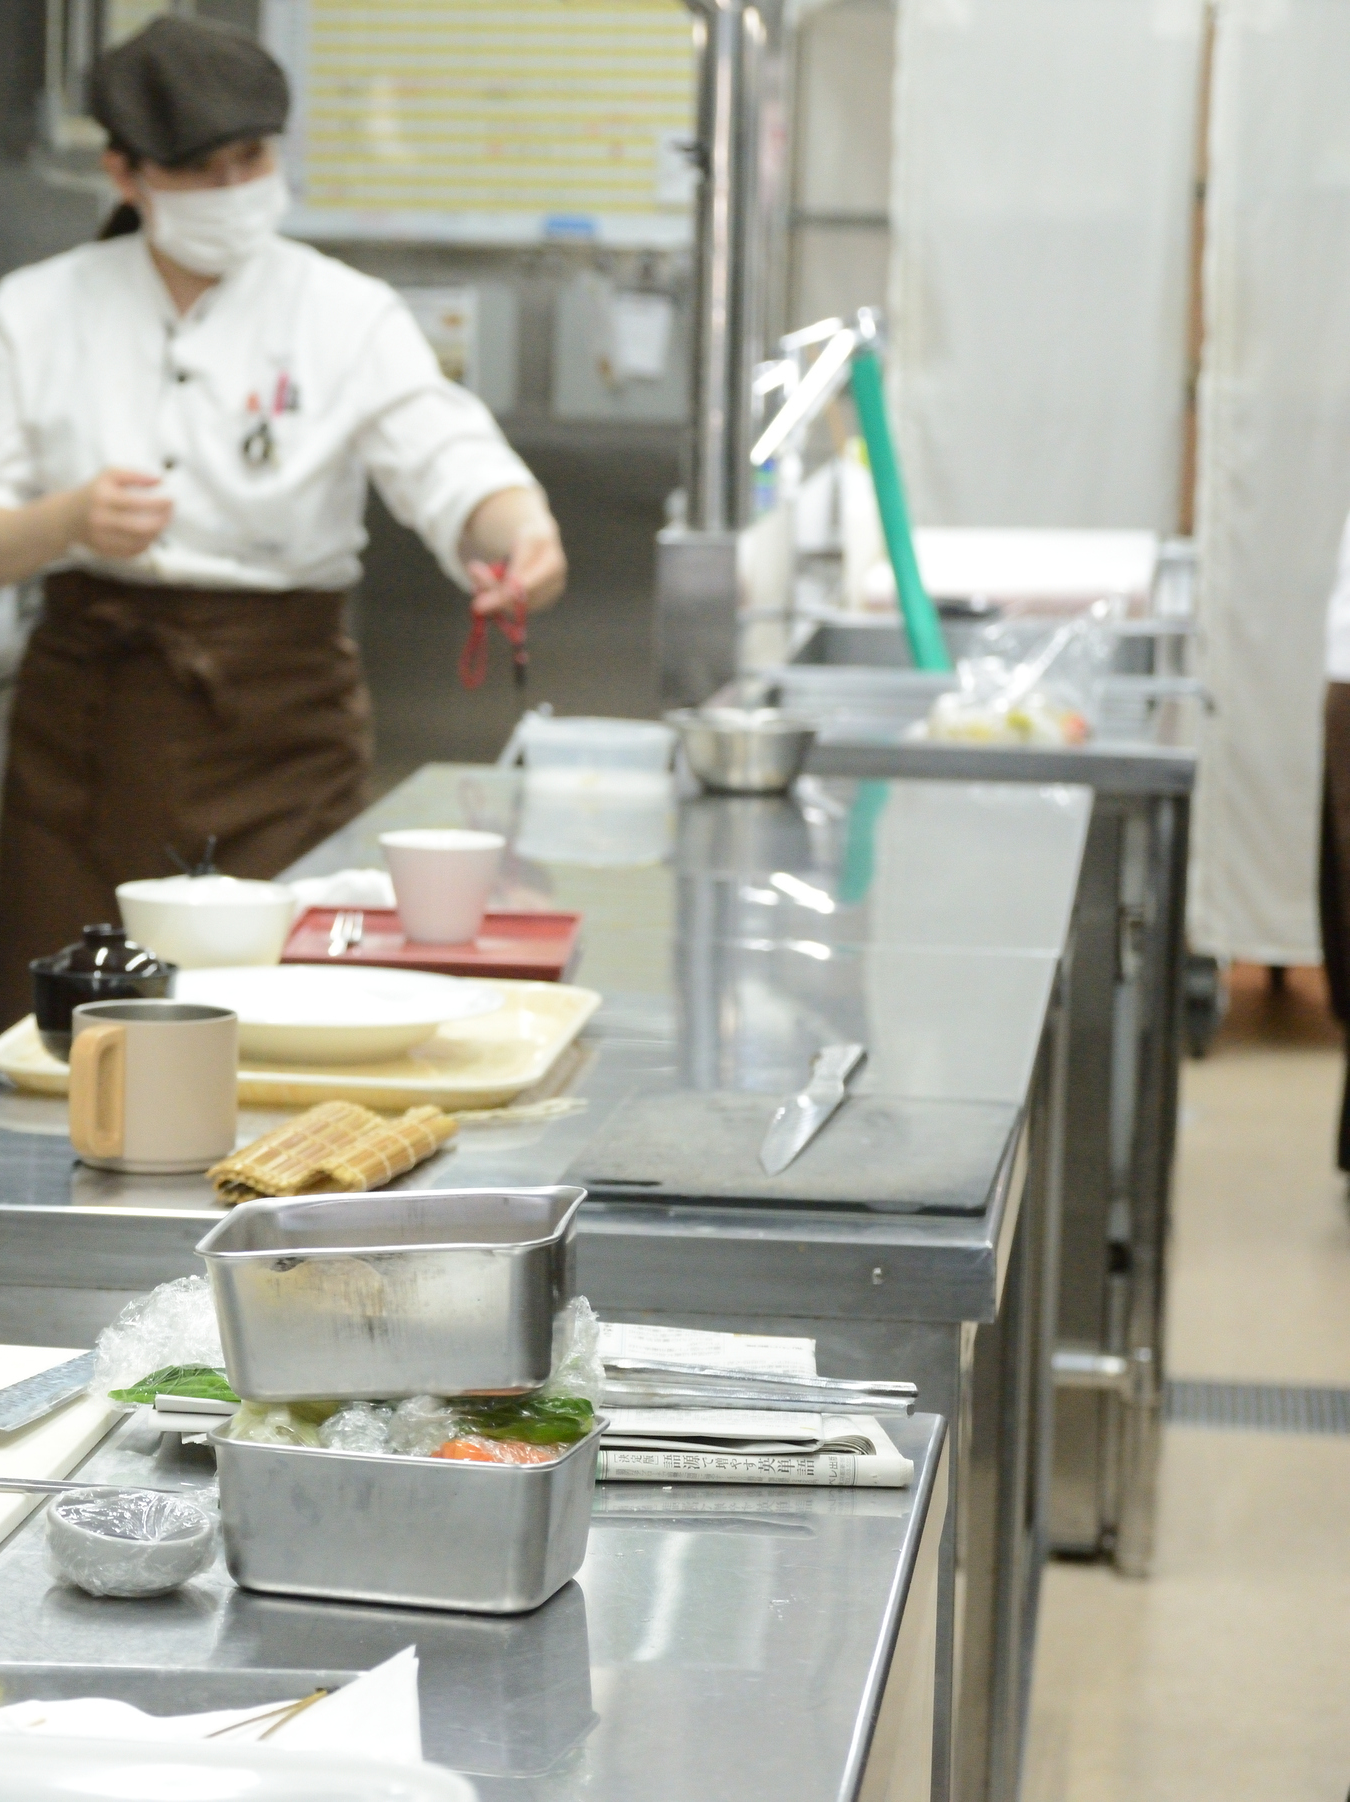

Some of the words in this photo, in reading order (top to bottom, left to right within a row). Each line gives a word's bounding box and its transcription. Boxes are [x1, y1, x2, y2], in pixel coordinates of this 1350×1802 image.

[663, 1454, 815, 1476] 語源で増やす英単語
